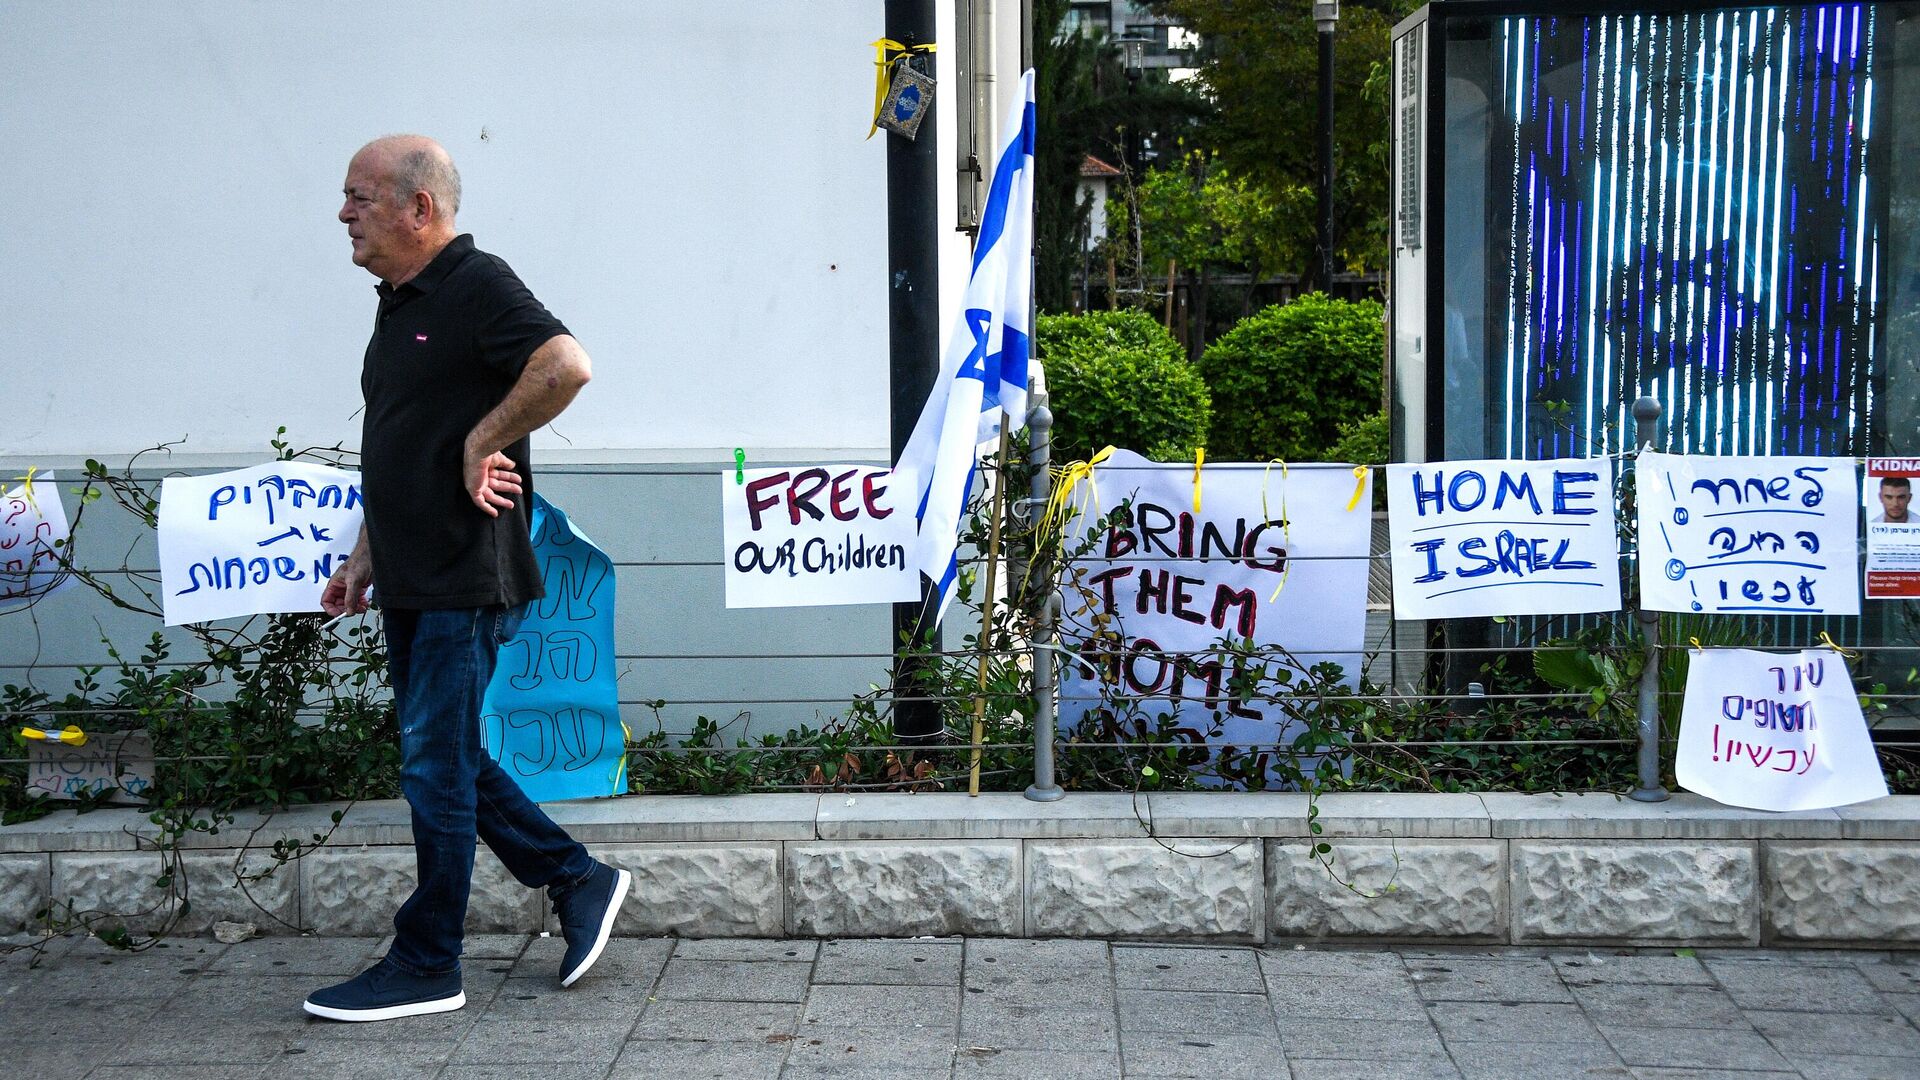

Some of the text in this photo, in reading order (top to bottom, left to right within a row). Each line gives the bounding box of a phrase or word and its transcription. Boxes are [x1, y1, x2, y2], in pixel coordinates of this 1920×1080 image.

[746, 468, 894, 531] FREE
[1412, 470, 1599, 516] HOME
[257, 523, 333, 546] את
[735, 532, 905, 577] OUR Children
[1105, 503, 1291, 573] BRING
[1410, 529, 1597, 584] ISRAEL
[1089, 566, 1257, 638] THEM
[38, 750, 141, 776] HOME
[1713, 724, 1816, 775] עכשיו!
